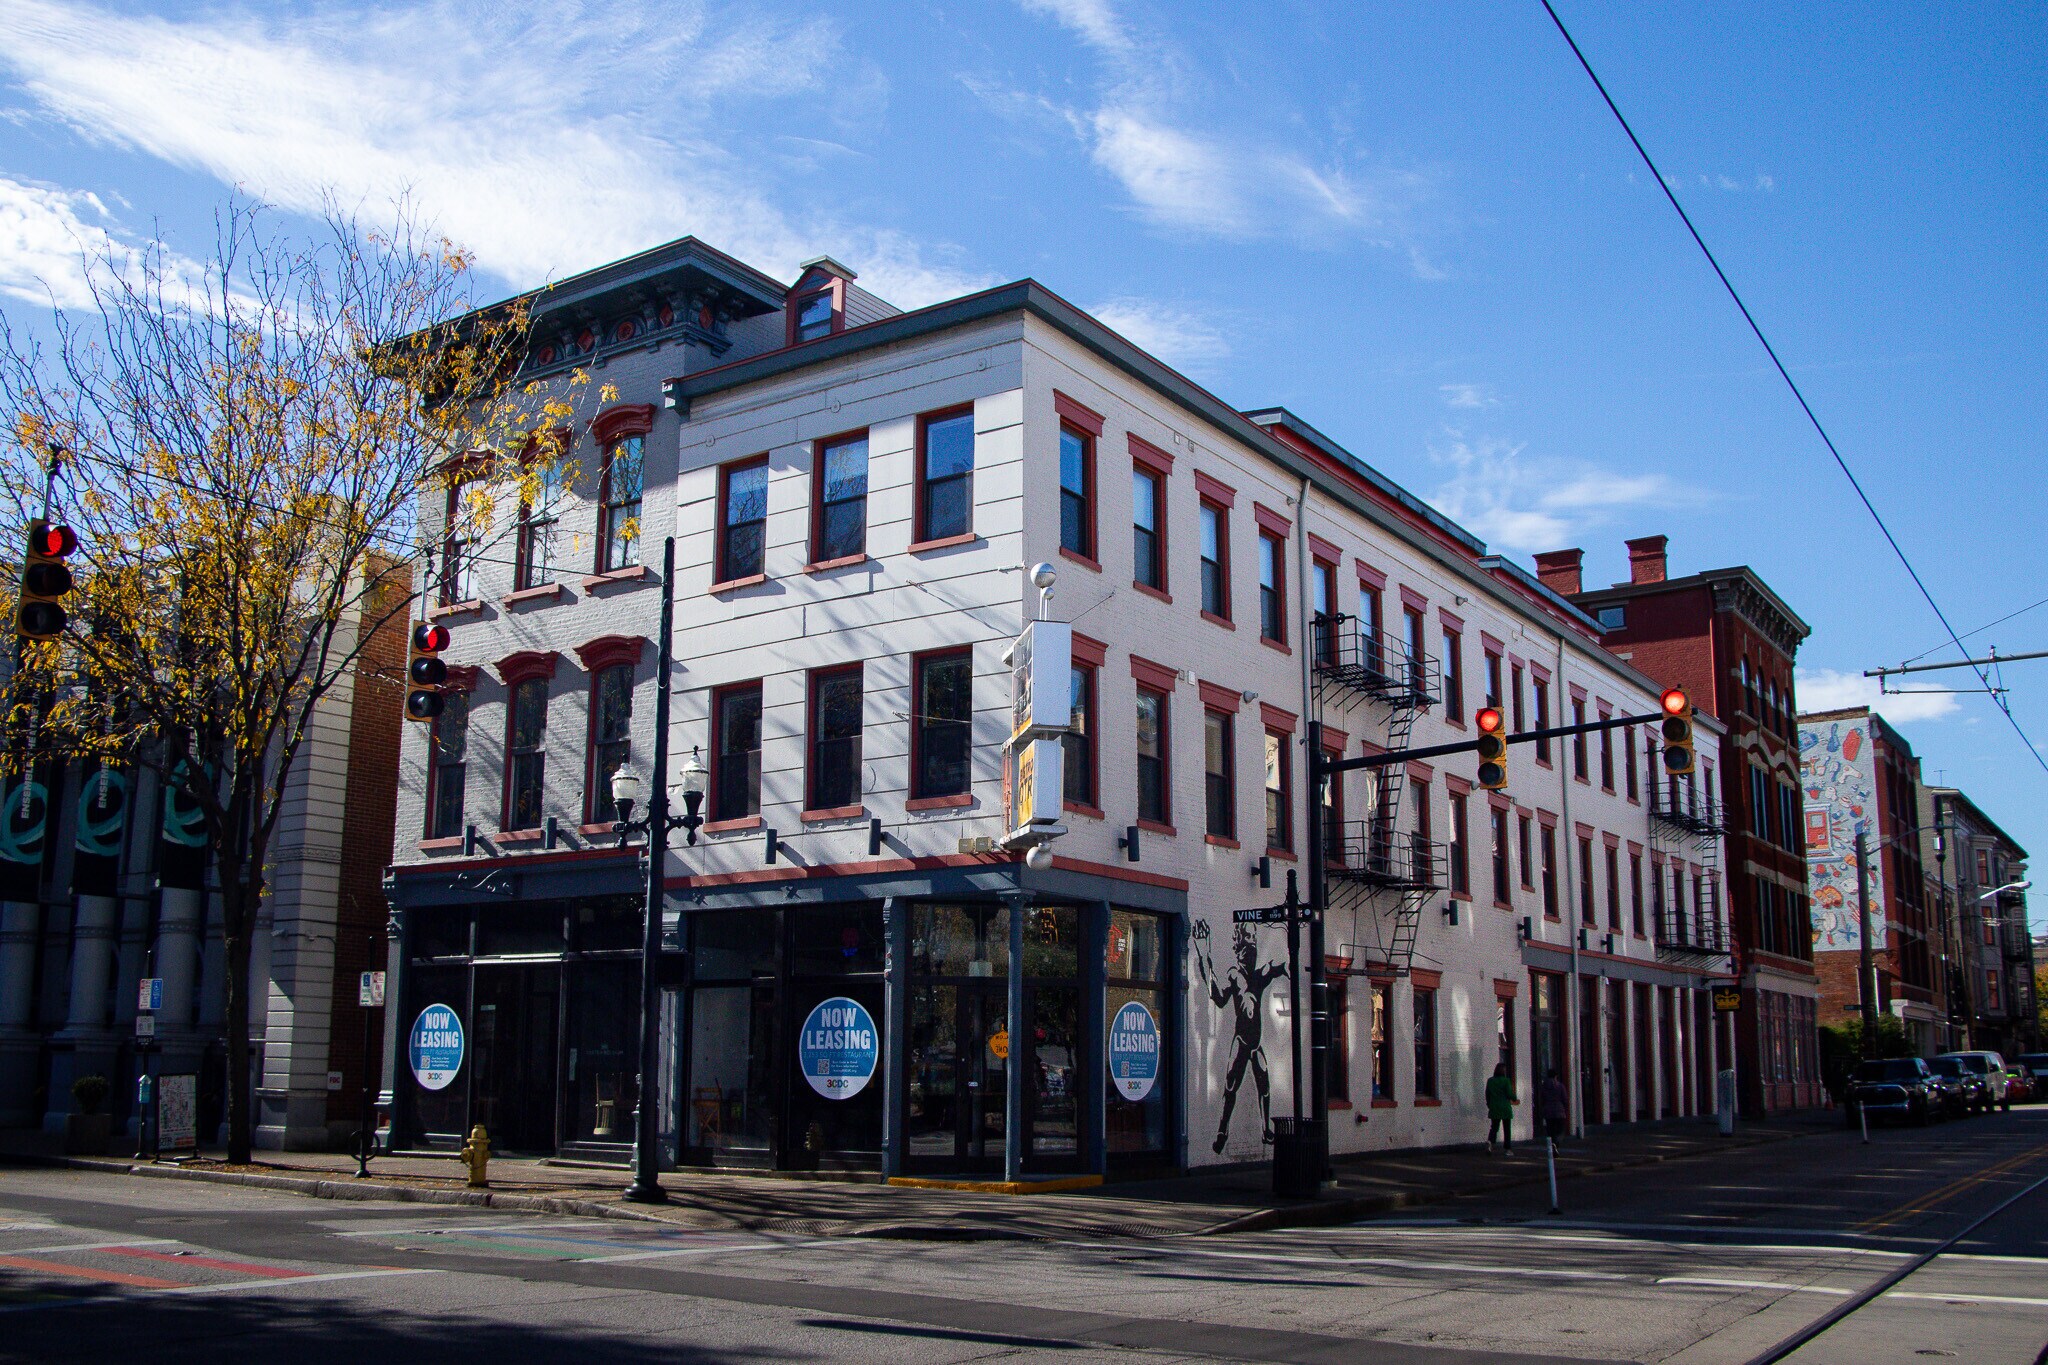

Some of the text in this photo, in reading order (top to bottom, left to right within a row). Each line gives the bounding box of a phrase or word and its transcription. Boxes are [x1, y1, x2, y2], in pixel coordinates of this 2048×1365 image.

[1237, 910, 1262, 920] VINE
[425, 1012, 451, 1029] NOW
[821, 1007, 857, 1028] NOW
[1123, 1011, 1147, 1031] NOW
[414, 1030, 459, 1048] LEASING
[806, 1029, 871, 1050] LEASING
[1113, 1032, 1155, 1053] LEASING
[427, 1072, 443, 1080] 3CDC
[827, 1080, 849, 1088] 3CDC
